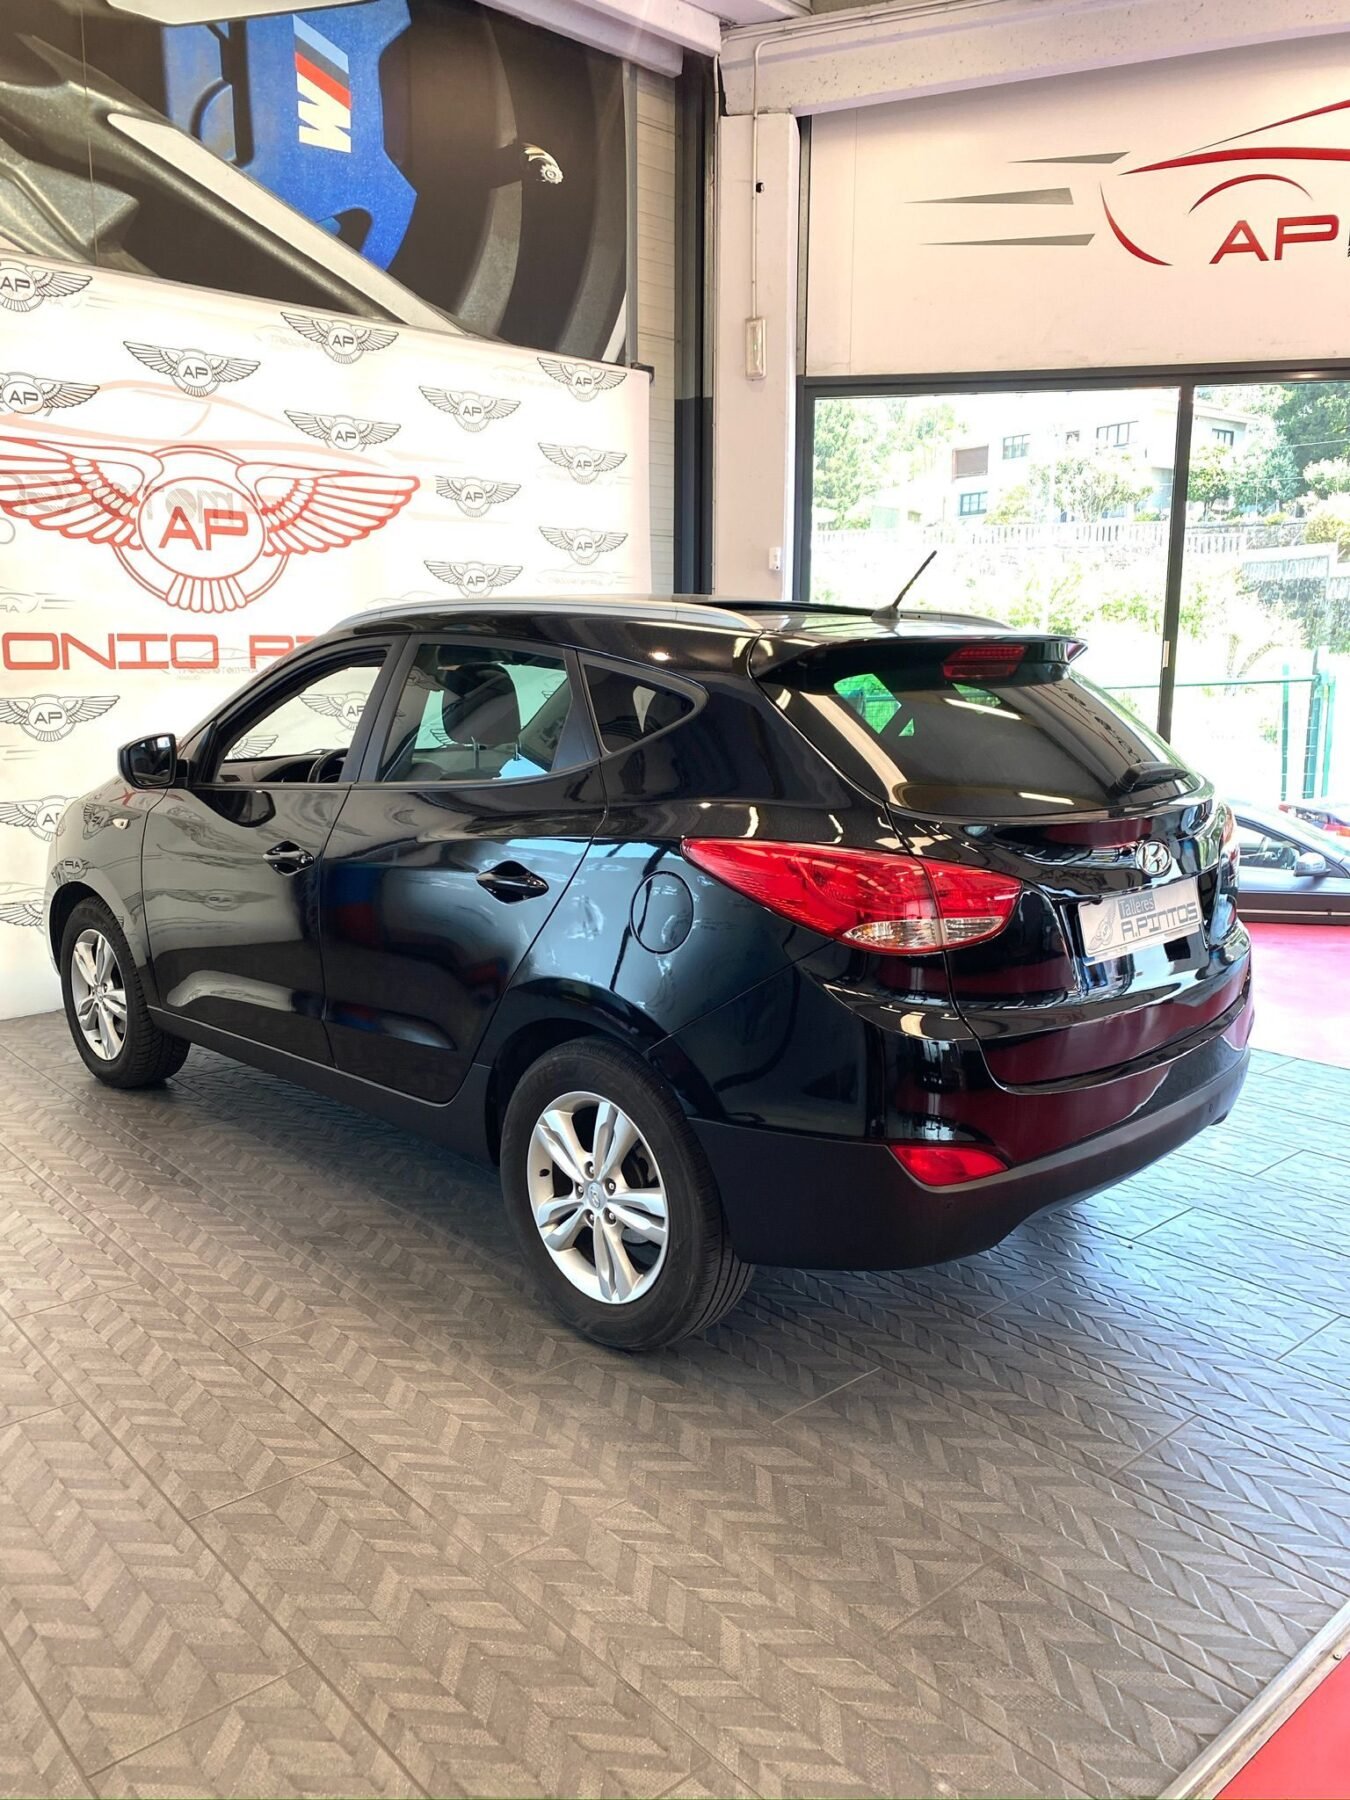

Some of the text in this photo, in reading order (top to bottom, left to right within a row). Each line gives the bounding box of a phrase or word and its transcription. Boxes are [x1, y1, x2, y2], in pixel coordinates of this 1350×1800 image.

[1209, 214, 1350, 265] AP
[0, 276, 31, 293] AP
[332, 335, 355, 348] AP
[183, 365, 209, 380] AP
[575, 376, 593, 386] AP
[8, 389, 39, 405] AP
[462, 406, 482, 417] AP
[335, 430, 357, 444] AP
[576, 460, 592, 470] AP
[464, 491, 484, 502] AP
[159, 505, 249, 551] AP
[576, 541, 593, 551] AP
[466, 576, 486, 587] AP
[249, 635, 317, 669] P
[34, 711, 63, 725] AP
[1121, 898, 1155, 917] Talleres
